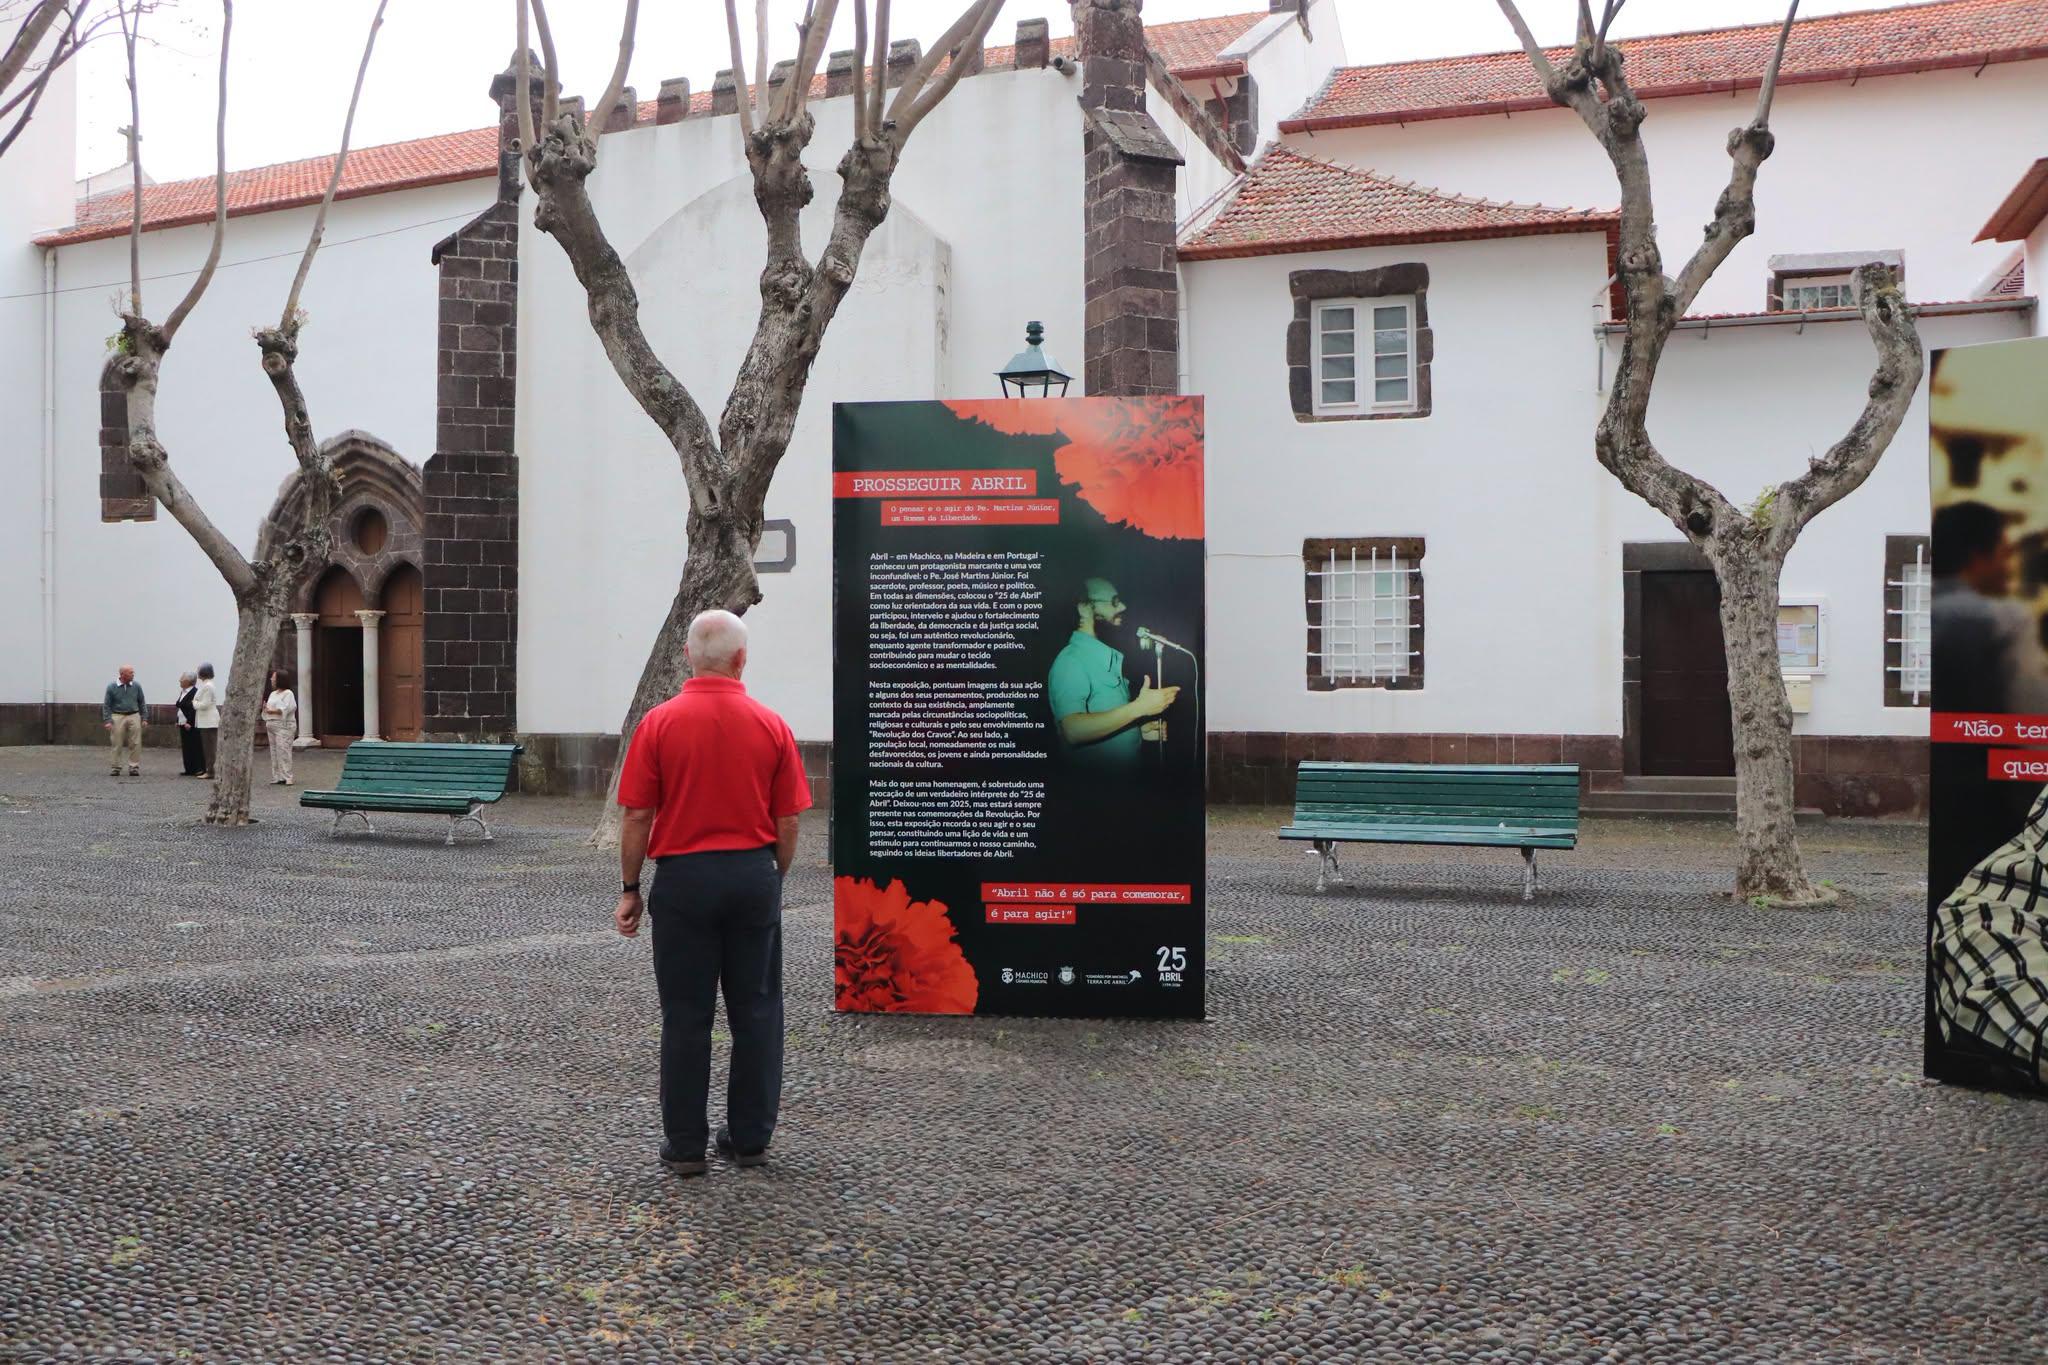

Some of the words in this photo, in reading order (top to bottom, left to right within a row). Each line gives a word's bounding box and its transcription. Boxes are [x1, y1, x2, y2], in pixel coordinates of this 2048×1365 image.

[853, 478, 961, 492] PROSSEGUIR
[971, 477, 1027, 491] ABRIL
[870, 552, 888, 560] Abril
[909, 552, 943, 560] Machico,
[954, 552, 986, 560] Madeira
[1006, 552, 1038, 561] Portugal
[870, 562, 906, 570] conheceu
[920, 562, 967, 571] protagonista
[968, 562, 1002, 570] marcante
[870, 572, 922, 580] inconfundível:
[930, 572, 942, 580] Pe.
[942, 572, 960, 580] José
[960, 572, 990, 580] Martins
[990, 572, 1016, 580] Júnior.
[870, 582, 908, 590] sacerdote,
[909, 582, 946, 591] professor,
[947, 582, 970, 591] poeta,
[972, 582, 998, 590] músico
[1006, 582, 1036, 590] político.
[883, 592, 904, 600] todas
[914, 592, 956, 600] dimensões,
[957, 592, 987, 600] colocou
[892, 602, 903, 610] luz
[904, 602, 947, 610] orientadora
[870, 612, 909, 620] participou,
[951, 612, 976, 620] ajudou
[880, 622, 916, 630] liberdade,
[990, 622, 1014, 630] justiça
[1016, 622, 1039, 630] social,
[880, 632, 897, 640] seja,
[960, 632, 1015, 640] revolucionário,
[869, 642, 904, 650] enquanto
[906, 642, 931, 650] agente
[994, 642, 1025, 650] positivo,
[892, 681, 931, 690] exposição,
[932, 682, 966, 690] pontuam
[967, 681, 998, 690] imagens
[1024, 682, 1042, 690] ação
[875, 692, 899, 700] alguns
[934, 692, 984, 700] pensamentos,
[986, 692, 1028, 700] produzidos
[969, 701, 1014, 709] amplamente
[902, 711, 921, 719] pelas
[976, 711, 1028, 720] sociopolíticas,
[869, 721, 903, 730] religiosas
[950, 721, 967, 729] pelo
[1953, 720, 2003, 737] “Não
[869, 741, 907, 749] população
[938, 751, 962, 759] jovens
[992, 751, 1047, 759] personalidades
[933, 780, 980, 789] homenagem,
[988, 780, 1026, 788] sobretudo
[869, 790, 904, 798] evocação
[929, 790, 969, 798] verdadeiro
[970, 790, 1008, 799] intérprete
[950, 800, 971, 808] 2025,
[990, 800, 1013, 808] estará
[870, 810, 902, 818] presente
[917, 810, 973, 818] comemorações
[986, 810, 1026, 819] Revolução.
[1028, 810, 1040, 818] Por
[904, 820, 941, 828] exposição
[994, 820, 1008, 829] agir
[962, 830, 980, 838] lição
[1002, 840, 1036, 848] caminho,
[870, 850, 903, 858] seguindo
[992, 889, 1029, 897] “Abril
[1060, 890, 1067, 898] é
[1073, 890, 1085, 898] só
[1091, 891, 1116, 900] para
[1123, 891, 1185, 900] comemorar,
[991, 909, 998, 917] é
[1004, 911, 1029, 920] para
[1035, 910, 1072, 920] agir!”
[1156, 946, 1187, 971] 25
[1159, 972, 1183, 982] ABRIL
